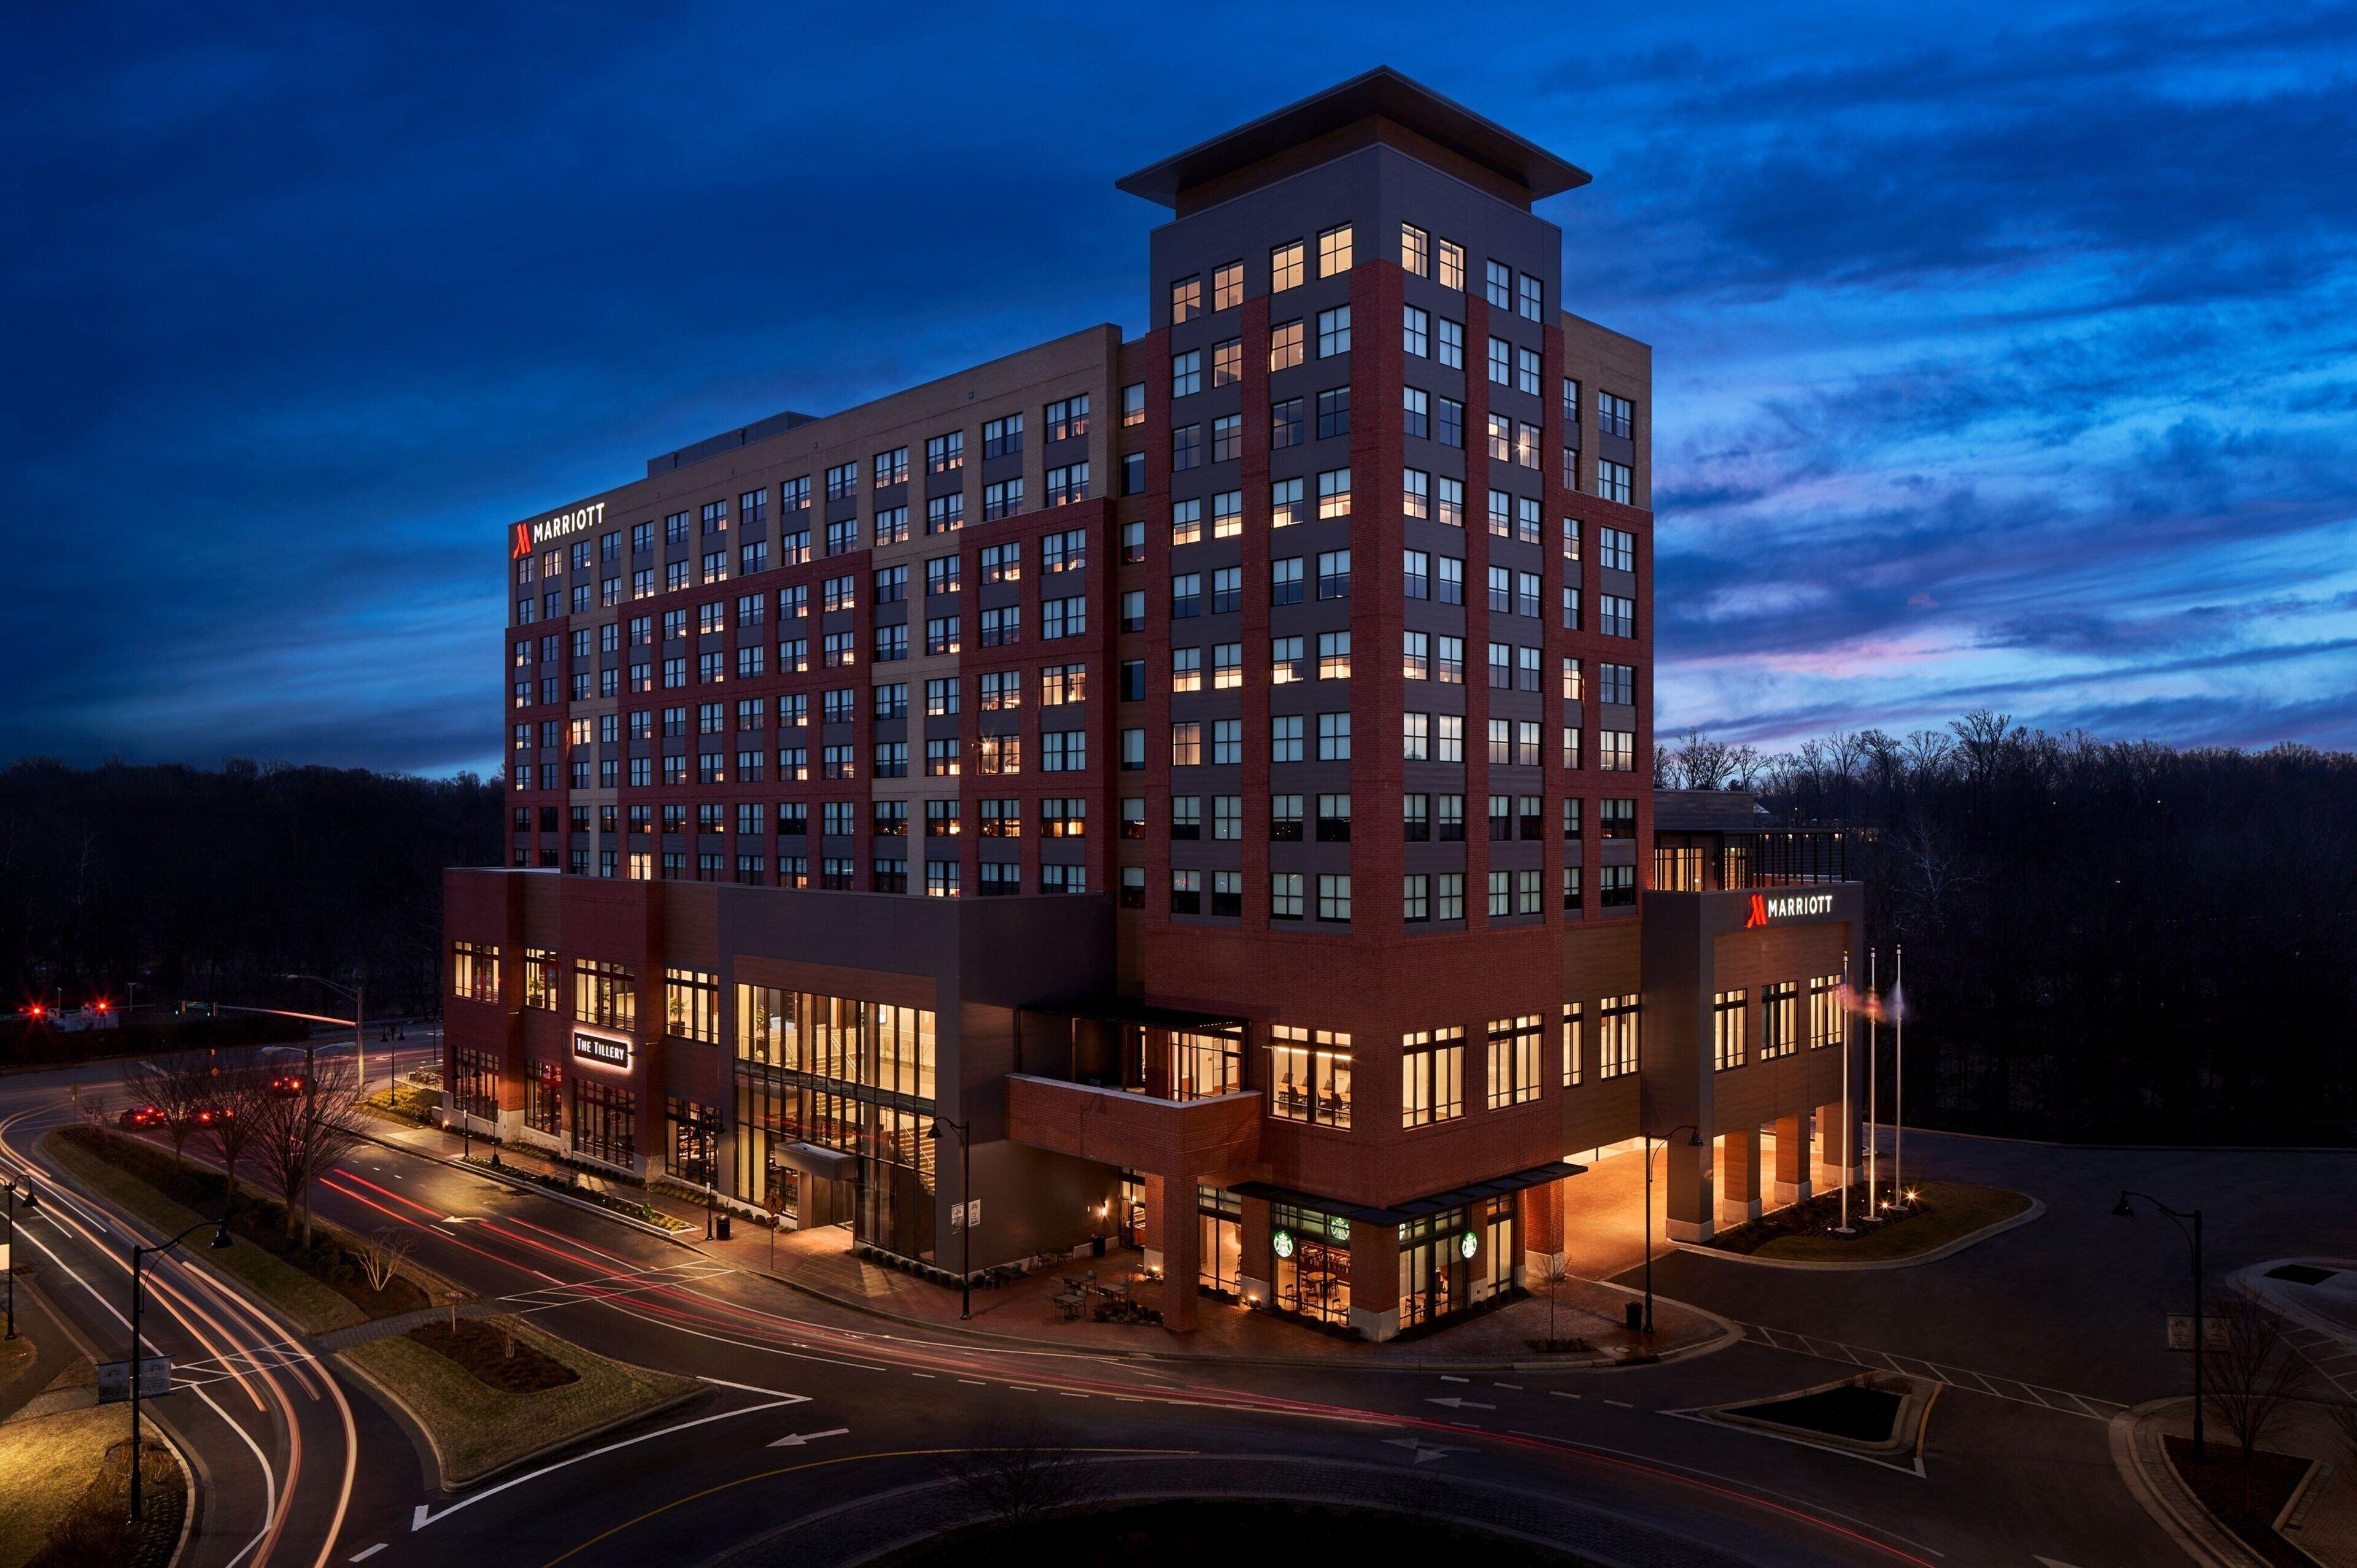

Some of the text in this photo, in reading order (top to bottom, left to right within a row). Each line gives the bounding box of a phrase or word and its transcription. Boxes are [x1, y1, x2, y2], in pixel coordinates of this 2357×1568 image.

[533, 502, 605, 544] MARRIOTT
[1768, 895, 1833, 917] MARRIOTT
[576, 1038, 625, 1060] THE TILLERY
